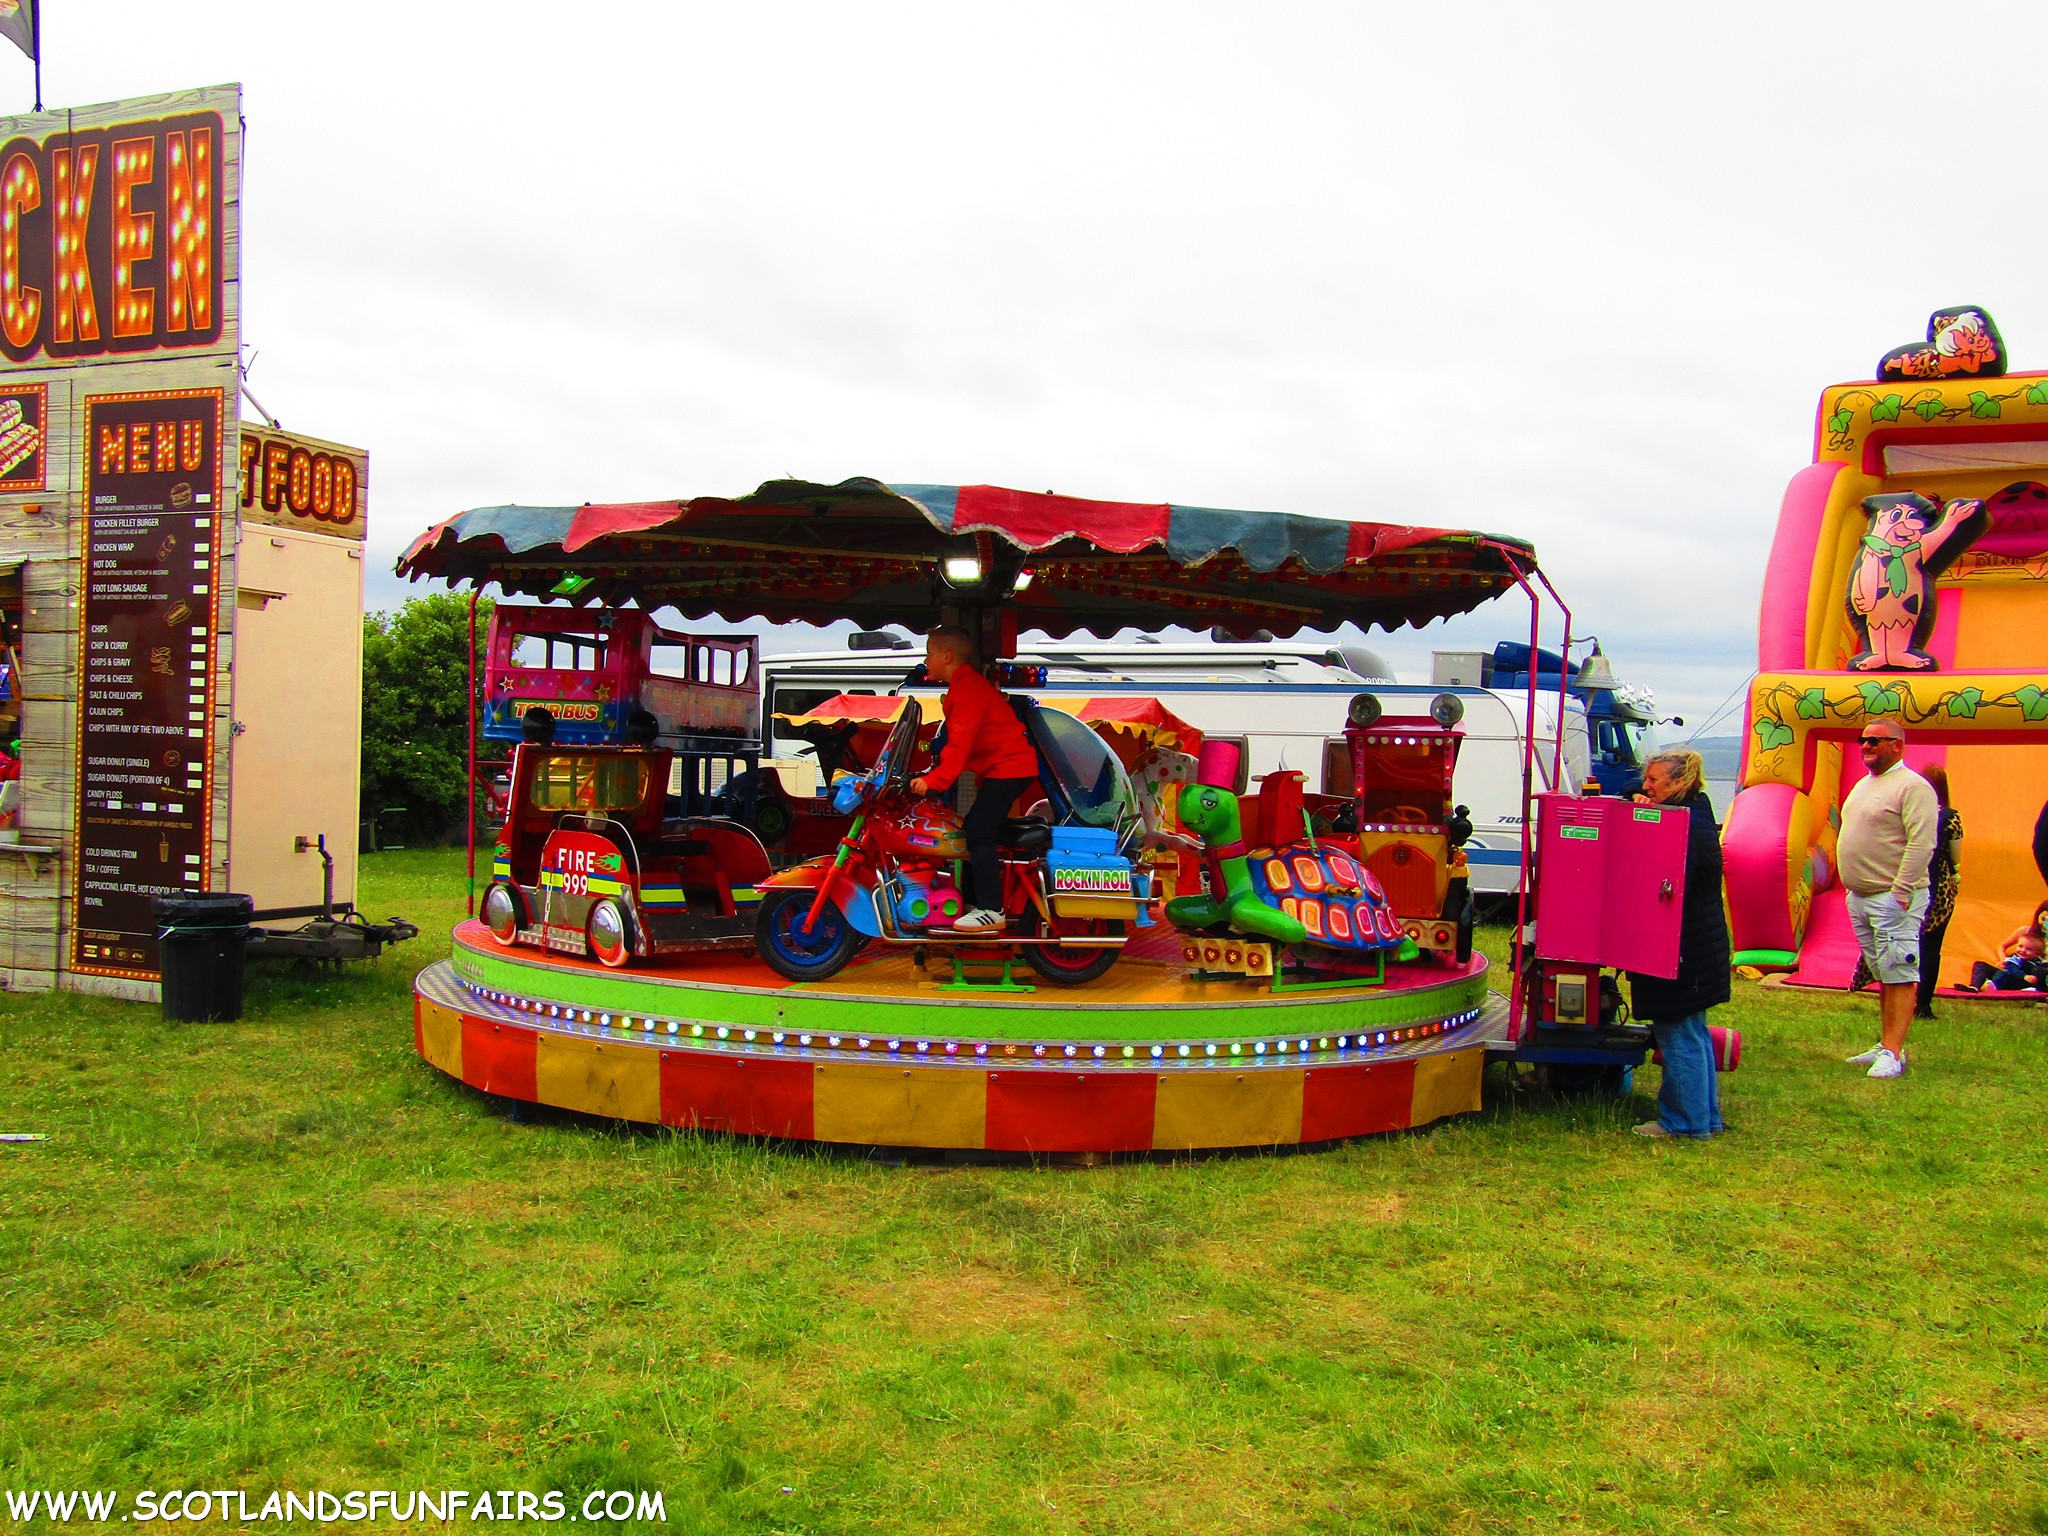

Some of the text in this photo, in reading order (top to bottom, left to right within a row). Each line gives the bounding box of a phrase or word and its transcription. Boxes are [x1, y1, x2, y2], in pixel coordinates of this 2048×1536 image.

[99, 420, 203, 474] MENU
[266, 445, 353, 518] FOOD
[95, 495, 118, 504] BURGER
[94, 518, 160, 528] CHICKEN FILLET BURGER
[93, 543, 135, 552] CHICKEN WRAP
[93, 560, 117, 568] HOT DOG
[92, 583, 148, 593] FOOT LONG SAUSAGE
[91, 624, 108, 633] CHIPS
[91, 641, 129, 650] CHIP & CURRY
[90, 657, 107, 666] CHIPS
[112, 657, 131, 667] GRAVY
[90, 674, 134, 684] CHIPS & CHEESE
[89, 690, 143, 700] SALT & CHILLI CHIPS
[89, 707, 124, 717] CAJUN CHIPS
[561, 703, 599, 720] BUS
[88, 723, 184, 735] CHIPS WITH ANY OF THE TWO ABOVE
[88, 756, 150, 769] SUGAR DONUT (SINGLE)
[88, 773, 106, 782] SUGAR
[106, 773, 128, 783] DONUTS
[129, 774, 155, 785] (PORTION
[155, 776, 163, 785] OF
[87, 789, 123, 799] CANDY FLOSS
[85, 847, 137, 859] COLD DRINKS FROM
[558, 847, 596, 873] FIRE
[85, 864, 96, 873] TEA
[100, 865, 120, 874] COFFEE
[563, 872, 588, 895] 999
[1055, 869, 1131, 891] ROCK N ROLL
[84, 880, 120, 892] CAPPUCCINO,
[120, 883, 137, 893] LATTE,
[137, 884, 149, 894] HOT
[84, 896, 104, 907] BOVRIL
